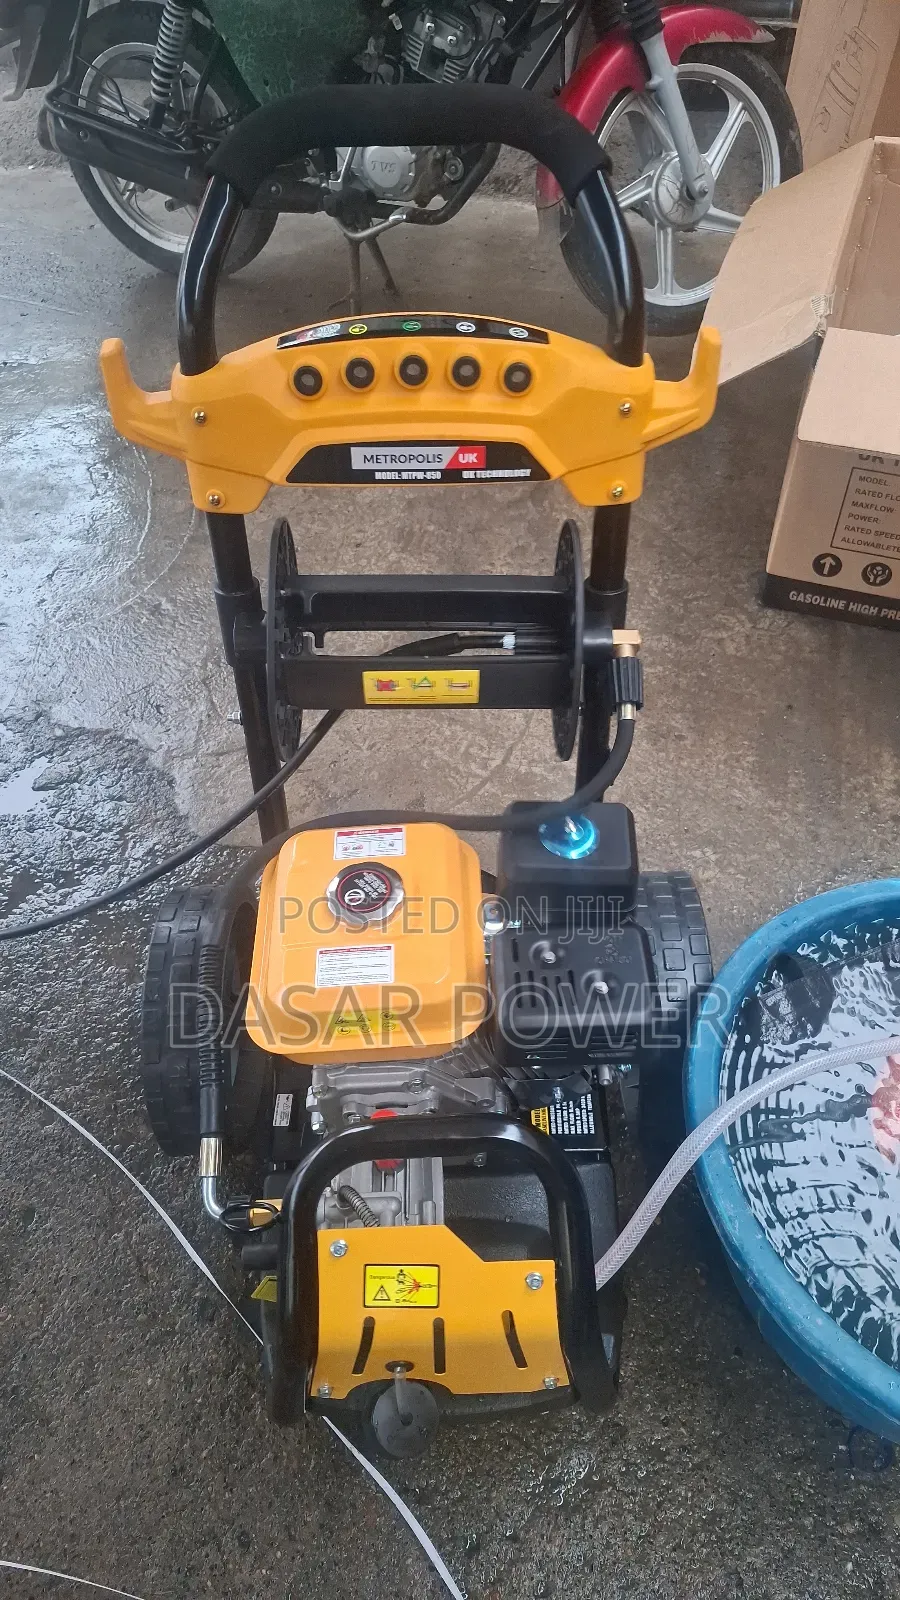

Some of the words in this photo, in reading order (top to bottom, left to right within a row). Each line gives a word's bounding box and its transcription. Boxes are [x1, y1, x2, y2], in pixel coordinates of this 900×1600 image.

[363, 454, 443, 464] METROPOLIS
[458, 453, 478, 463] UK
[854, 488, 883, 499] RATED
[844, 524, 872, 535] RATED
[873, 530, 900, 541] SPEED
[789, 591, 847, 610] GASOLINE
[848, 602, 879, 616] HIGH
